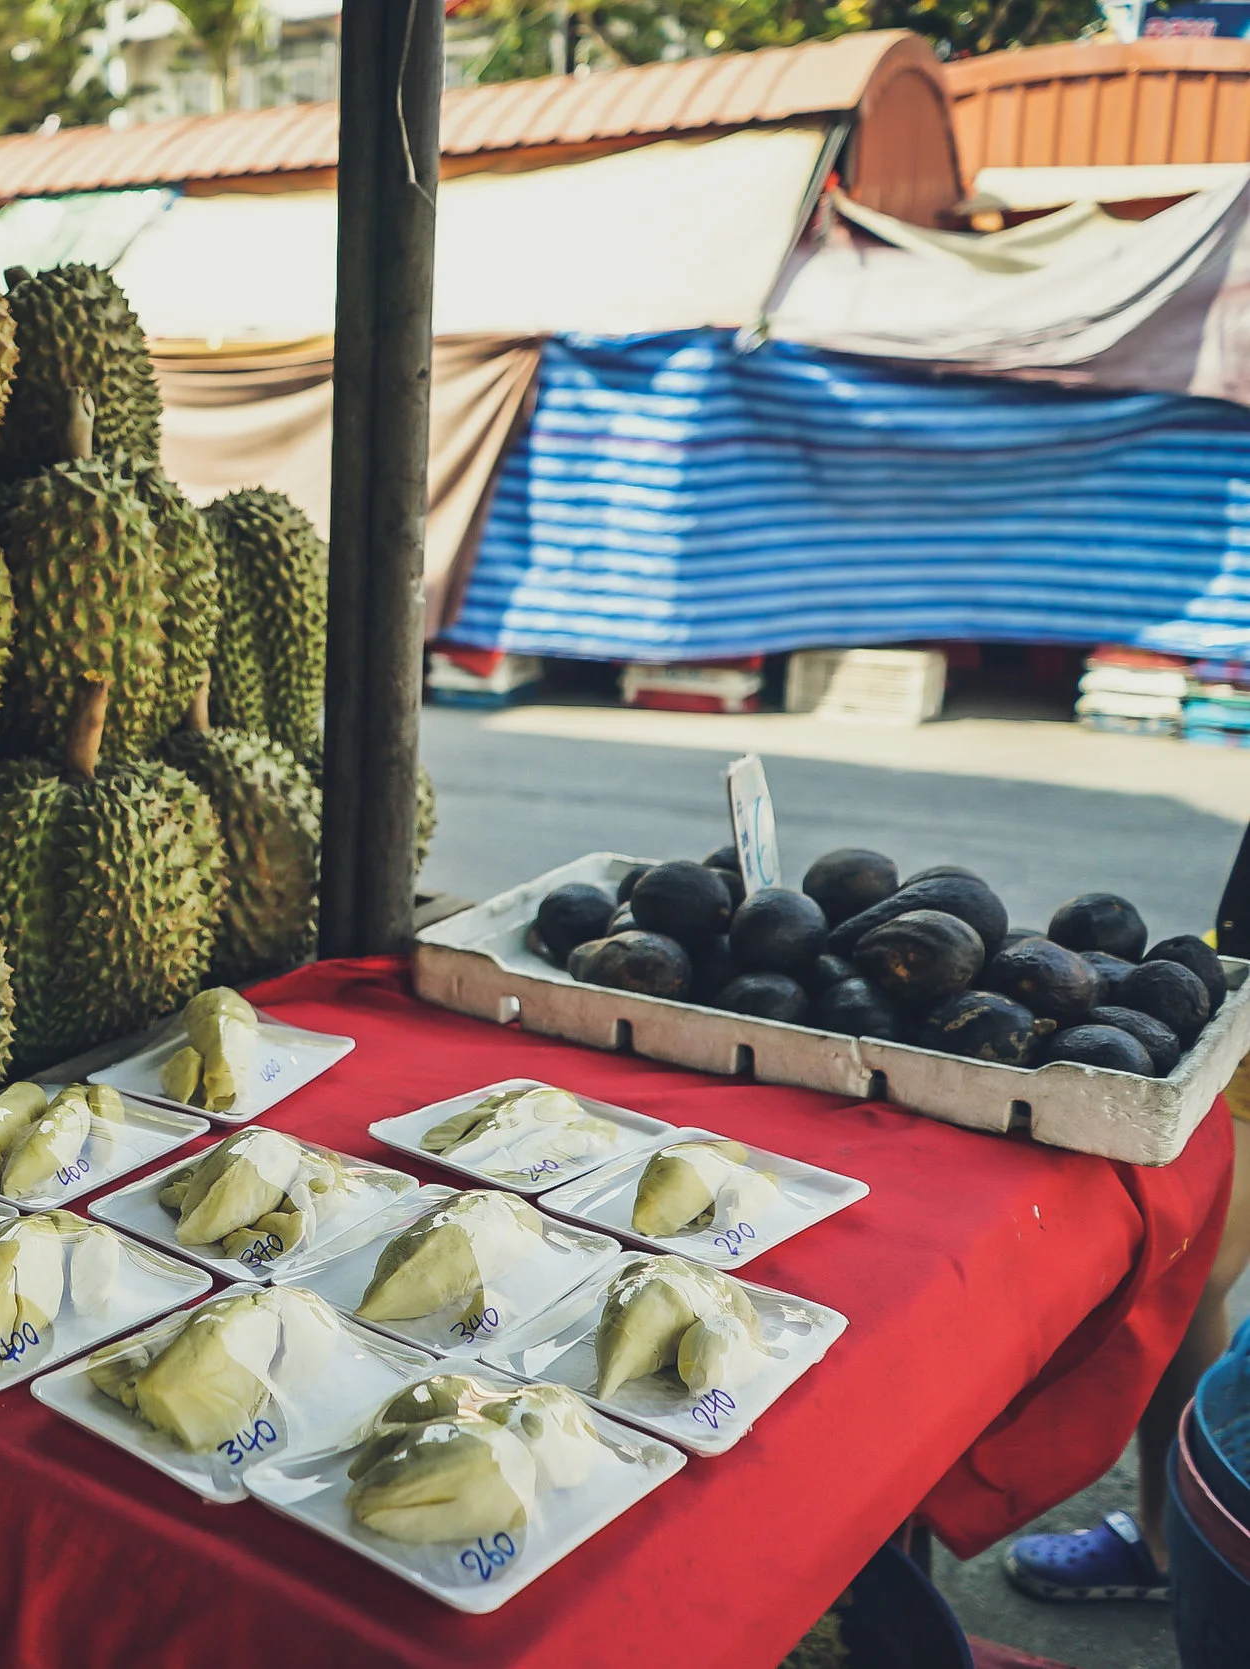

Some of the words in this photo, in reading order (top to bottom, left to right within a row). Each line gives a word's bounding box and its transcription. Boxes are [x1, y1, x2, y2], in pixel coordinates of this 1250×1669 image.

[56, 1158, 90, 1186] 400
[520, 1159, 559, 1182] 240
[240, 1233, 284, 1269] 370
[449, 1307, 499, 1344] 340
[692, 1388, 736, 1430] 240
[216, 1419, 277, 1466] 340
[460, 1531, 516, 1581] 260
